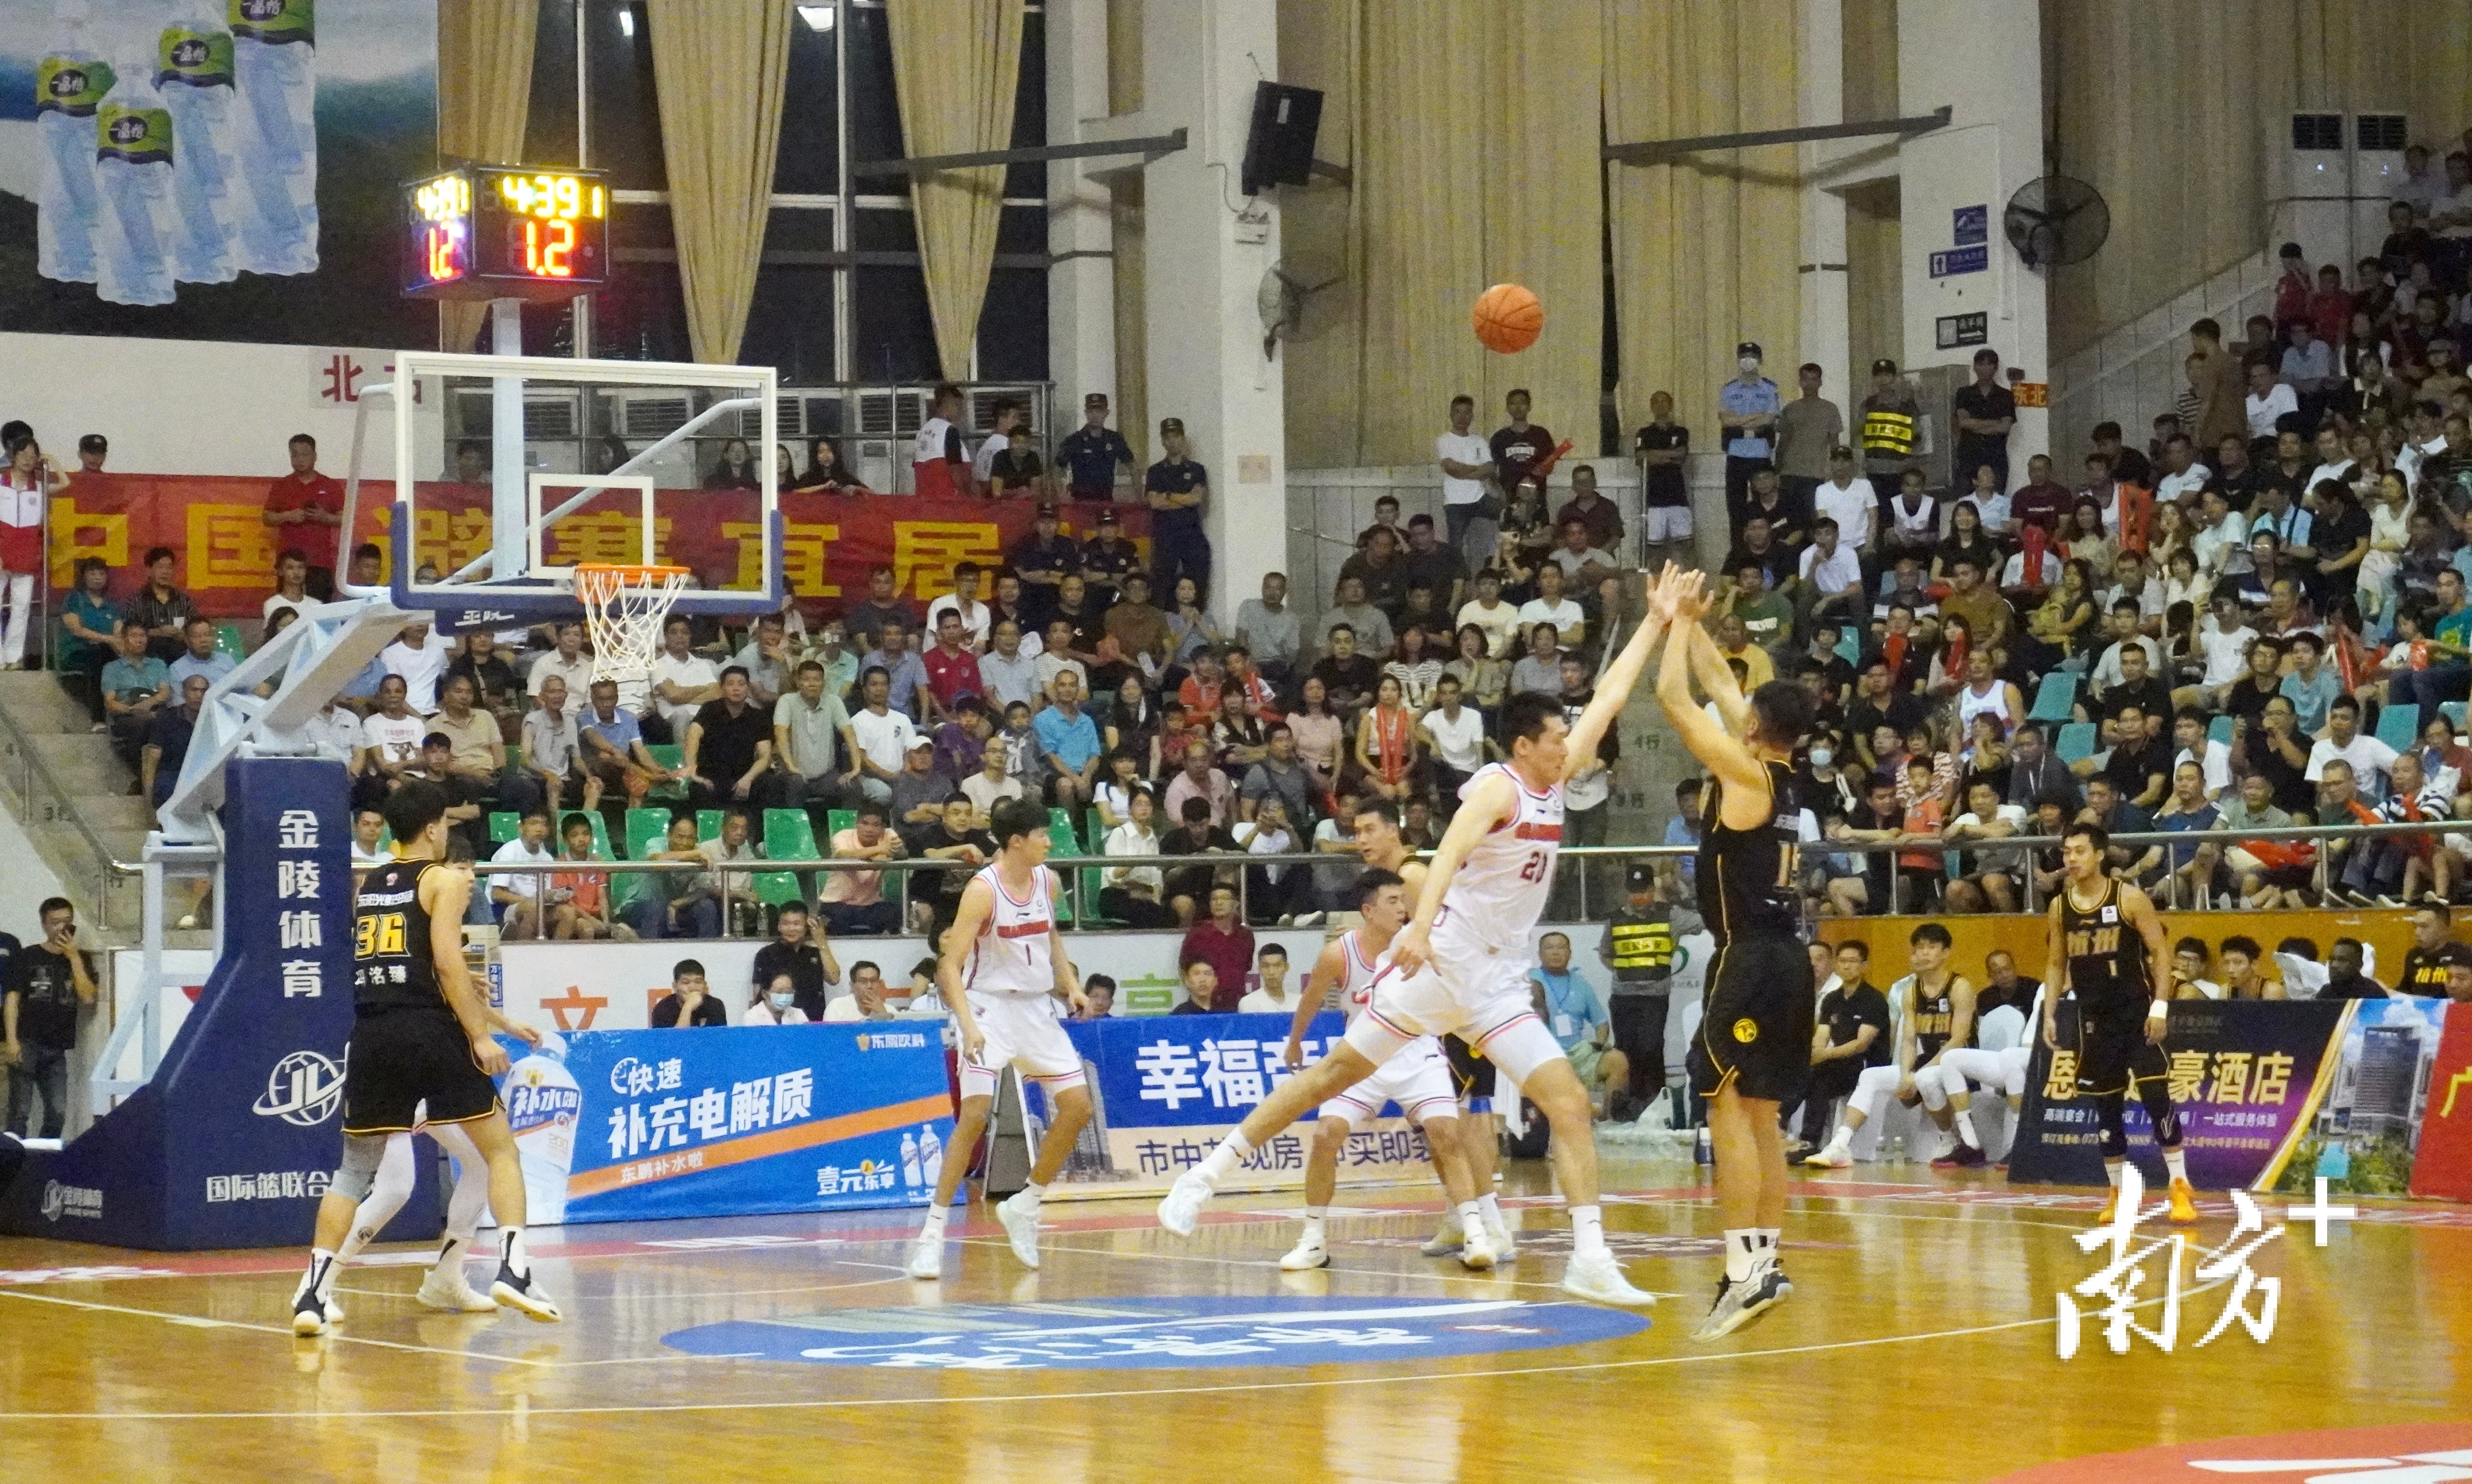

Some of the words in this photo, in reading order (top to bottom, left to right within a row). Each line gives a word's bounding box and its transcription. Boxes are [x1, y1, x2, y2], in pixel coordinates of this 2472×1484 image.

[527, 219, 574, 276] 1.2
[51, 496, 1153, 607] 中国避寒宜居
[278, 810, 322, 998] 金陵体育
[355, 911, 411, 961] 36
[1025, 943, 1032, 966] 1
[2108, 960, 2117, 976] 1
[628, 1058, 683, 1097] 快速
[1135, 1036, 1342, 1110] 幸福帝
[2042, 1049, 2295, 1106] 恩豪酒店
[607, 1067, 813, 1159] 补充电解质
[620, 1151, 704, 1184] 东鹏补水啦
[1136, 1134, 1304, 1176] 市中现房
[1334, 1129, 1432, 1166] 买即
